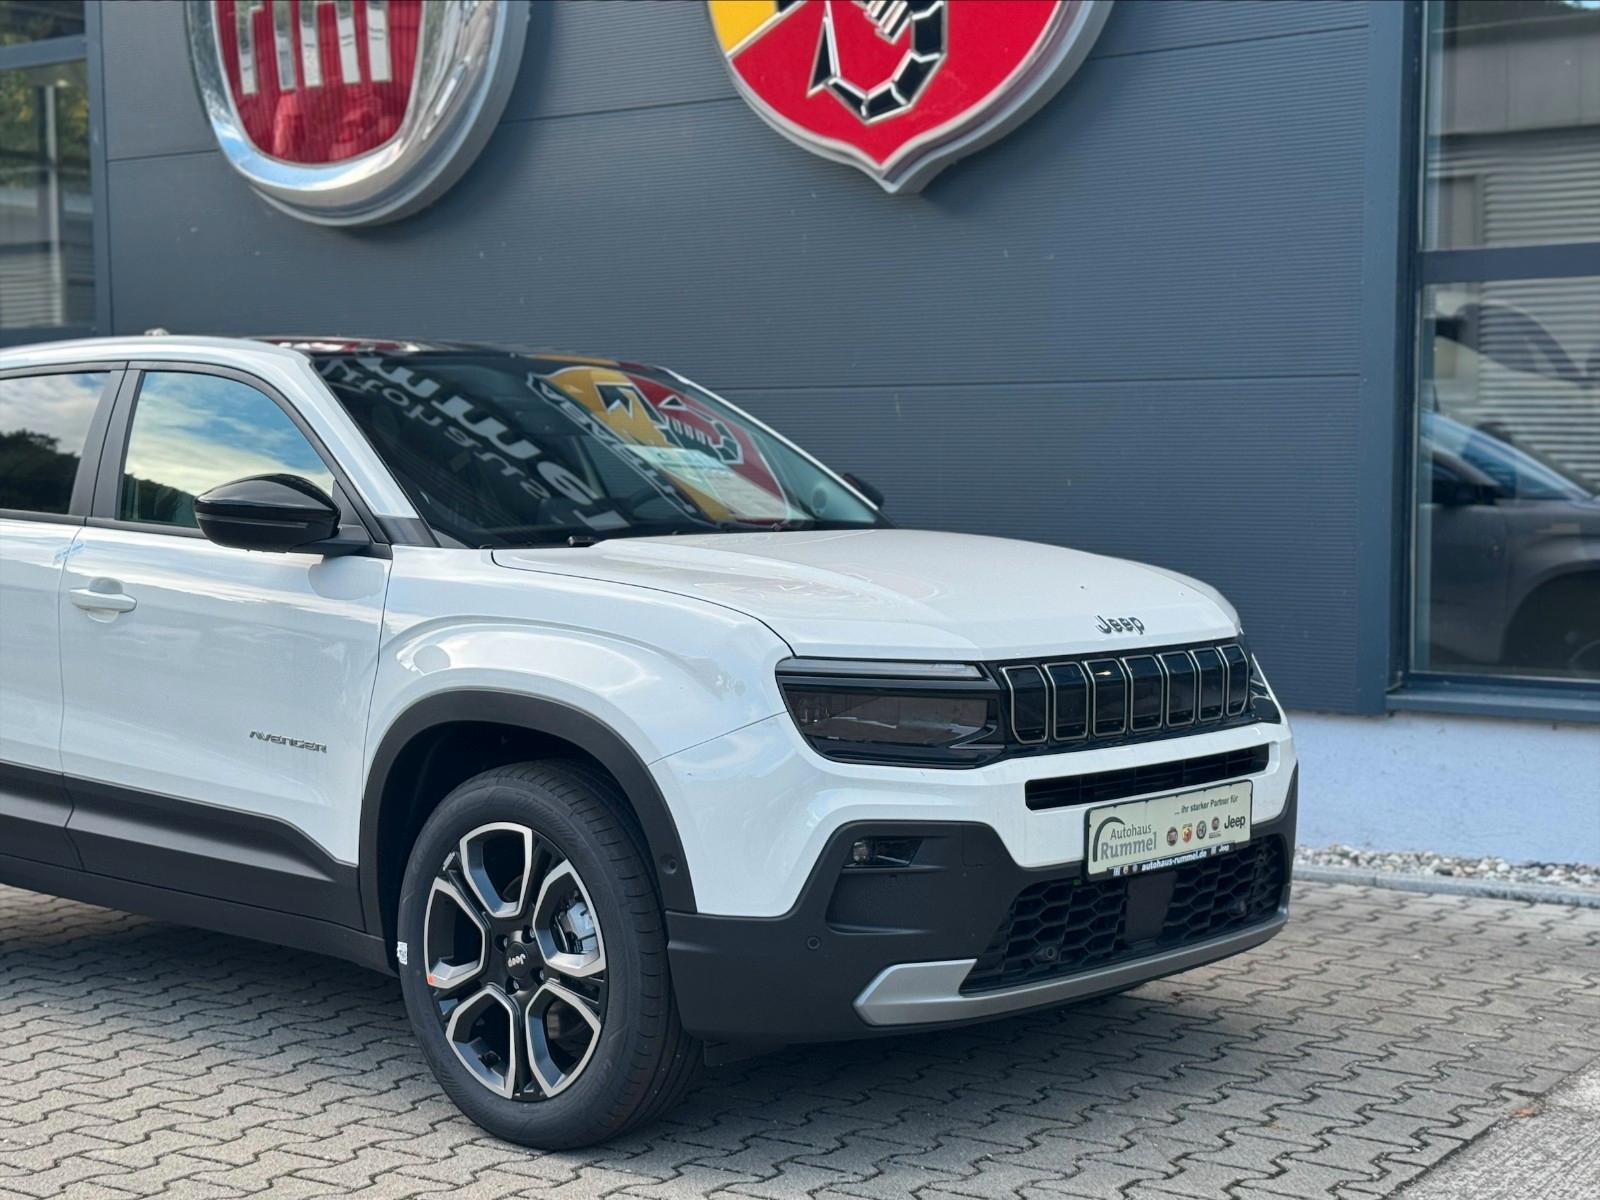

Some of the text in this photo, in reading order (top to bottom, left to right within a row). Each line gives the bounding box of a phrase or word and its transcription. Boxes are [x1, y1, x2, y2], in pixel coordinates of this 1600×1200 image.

[1095, 615, 1144, 635] Jeep
[249, 731, 327, 753] AVENGER
[1190, 801, 1210, 812] starker
[1210, 797, 1230, 808] Partner
[1230, 794, 1239, 803] für
[1224, 814, 1246, 830] Jeep
[1110, 824, 1152, 840] Autohaus
[1100, 832, 1157, 861] Rummel
[1141, 850, 1207, 872] autohaus-rummel.de
[507, 953, 527, 968] Jeep
